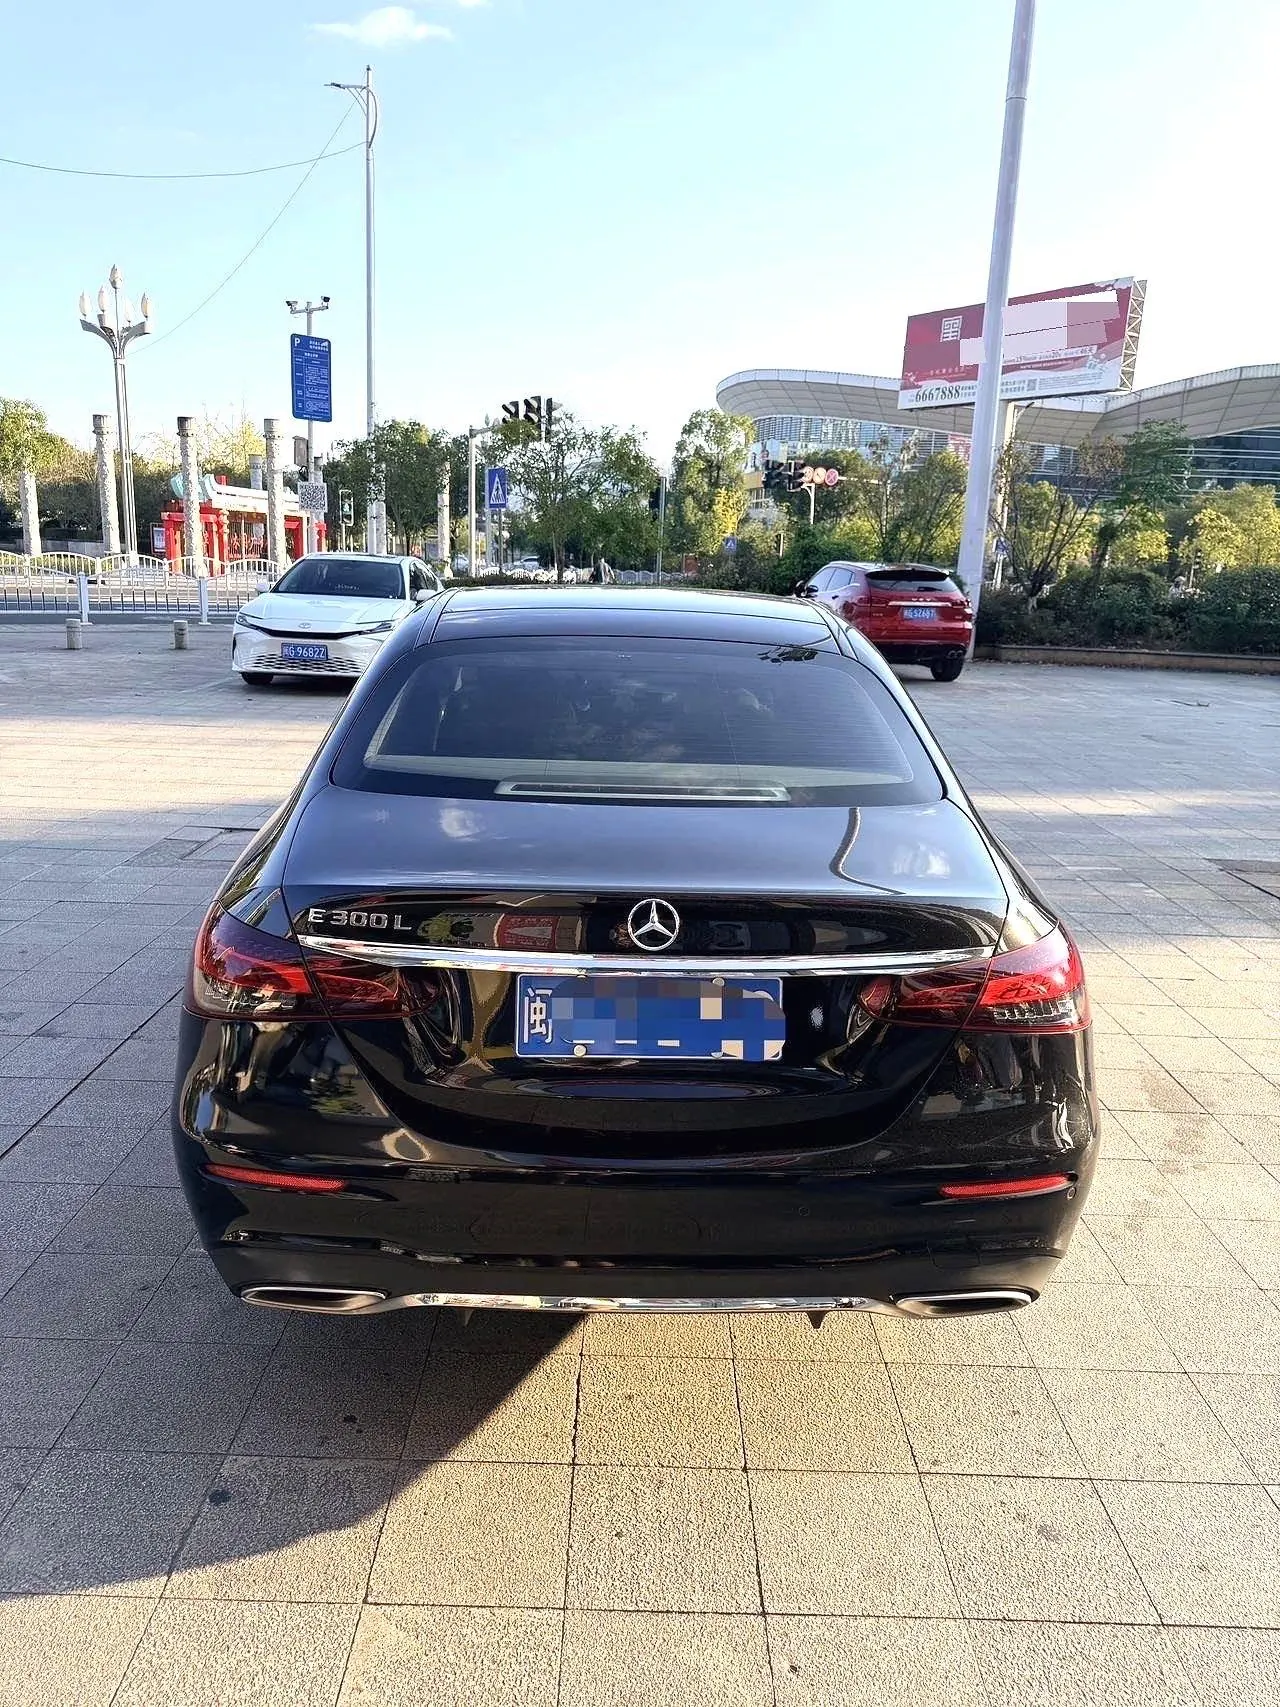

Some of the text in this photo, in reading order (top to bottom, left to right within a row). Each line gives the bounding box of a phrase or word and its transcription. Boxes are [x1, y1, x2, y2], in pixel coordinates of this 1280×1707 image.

[294, 338, 301, 347] P
[915, 385, 961, 402] 6667888
[524, 987, 553, 1043] 闽
